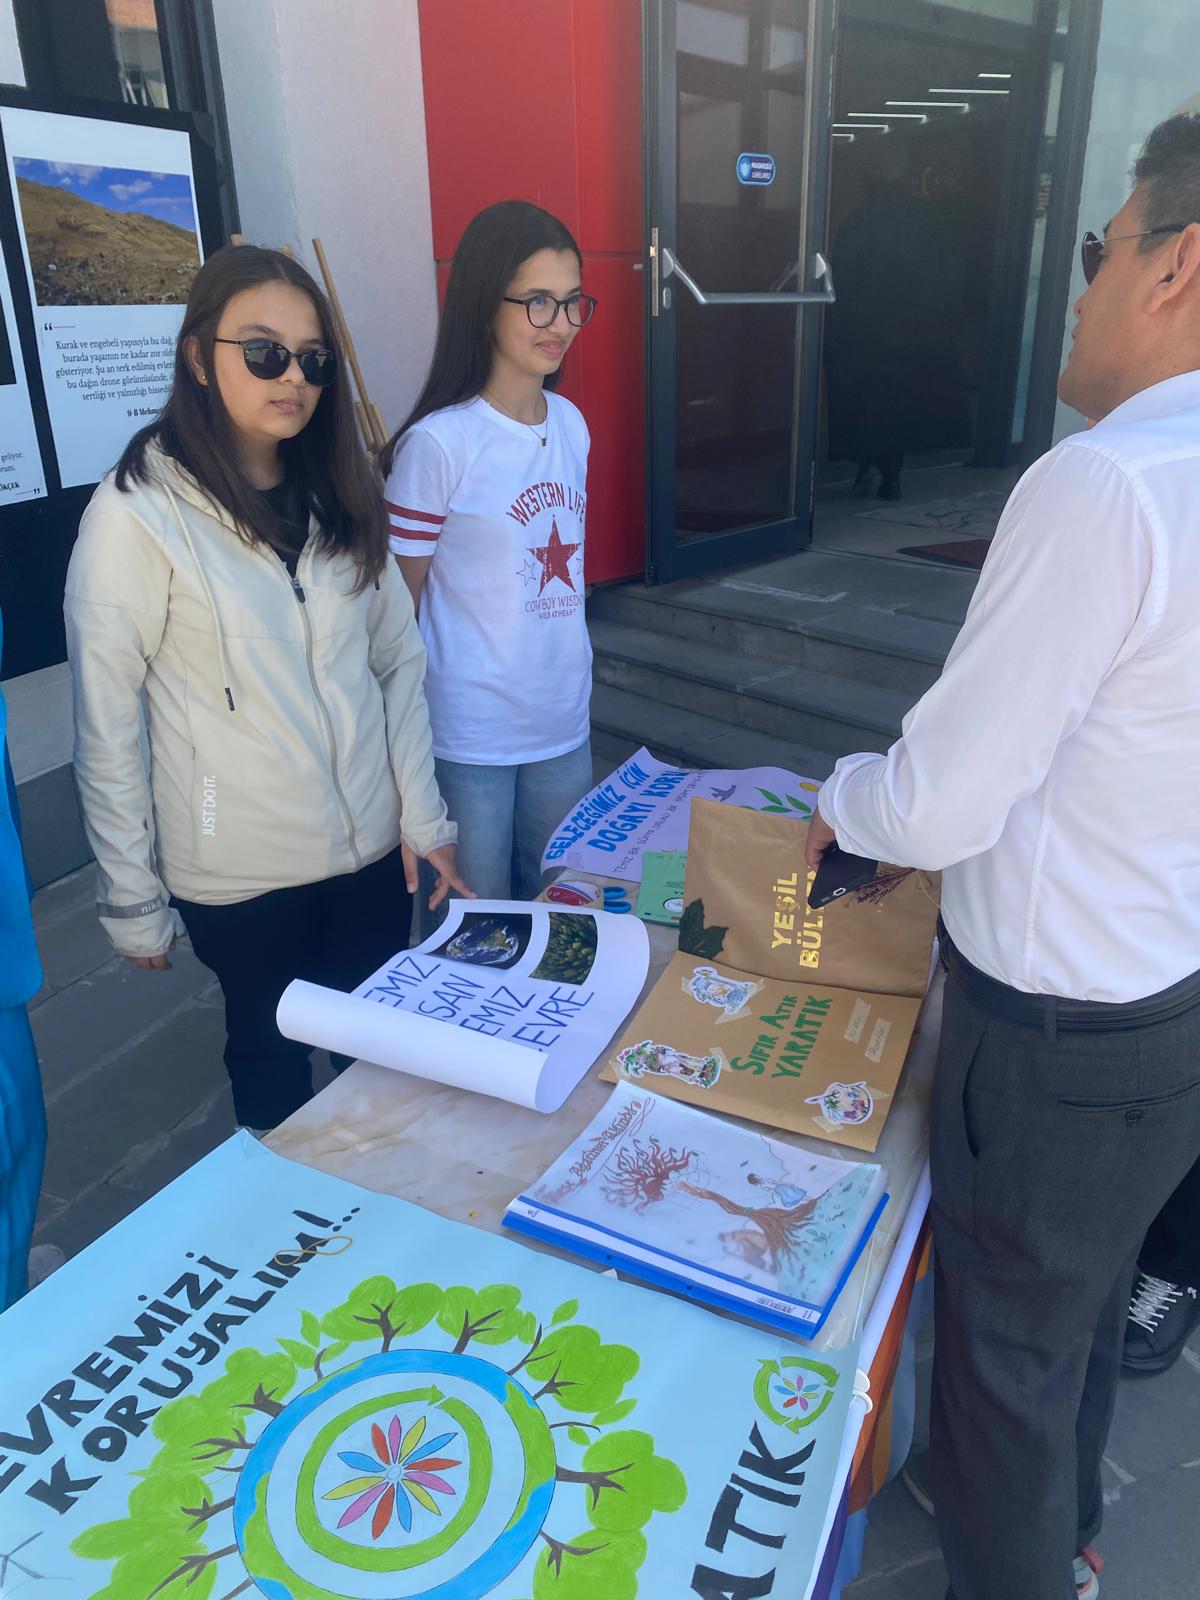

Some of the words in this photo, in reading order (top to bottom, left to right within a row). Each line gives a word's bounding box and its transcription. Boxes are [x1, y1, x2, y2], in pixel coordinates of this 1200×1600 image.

[56, 340, 79, 350] Kurak
[80, 340, 88, 349] ve
[90, 338, 119, 351] engebeli
[150, 336, 159, 345] bu
[63, 353, 89, 363] burada
[90, 352, 119, 363] yaşamın
[121, 352, 129, 360] ne
[130, 349, 149, 359] kadar
[67, 379, 77, 389] bu
[79, 378, 99, 390] dağın
[100, 377, 121, 387] drone
[95, 364, 105, 376] Şu
[116, 362, 130, 372] terk
[131, 362, 156, 372] edilmiş
[506, 481, 565, 527] WESTERN
[525, 597, 556, 613] COWBOY
[203, 775, 217, 787] IT.
[203, 788, 217, 808] DO
[201, 808, 217, 838] JUST
[586, 801, 657, 853] DOĞAYI
[771, 872, 798, 949] YEŞİL
[796, 866, 825, 969] BÜL
[511, 985, 595, 1050] EVRE
[730, 1033, 780, 1076] SIFIR
[758, 994, 798, 1031] ATIK
[770, 994, 833, 1079] YARATIK
